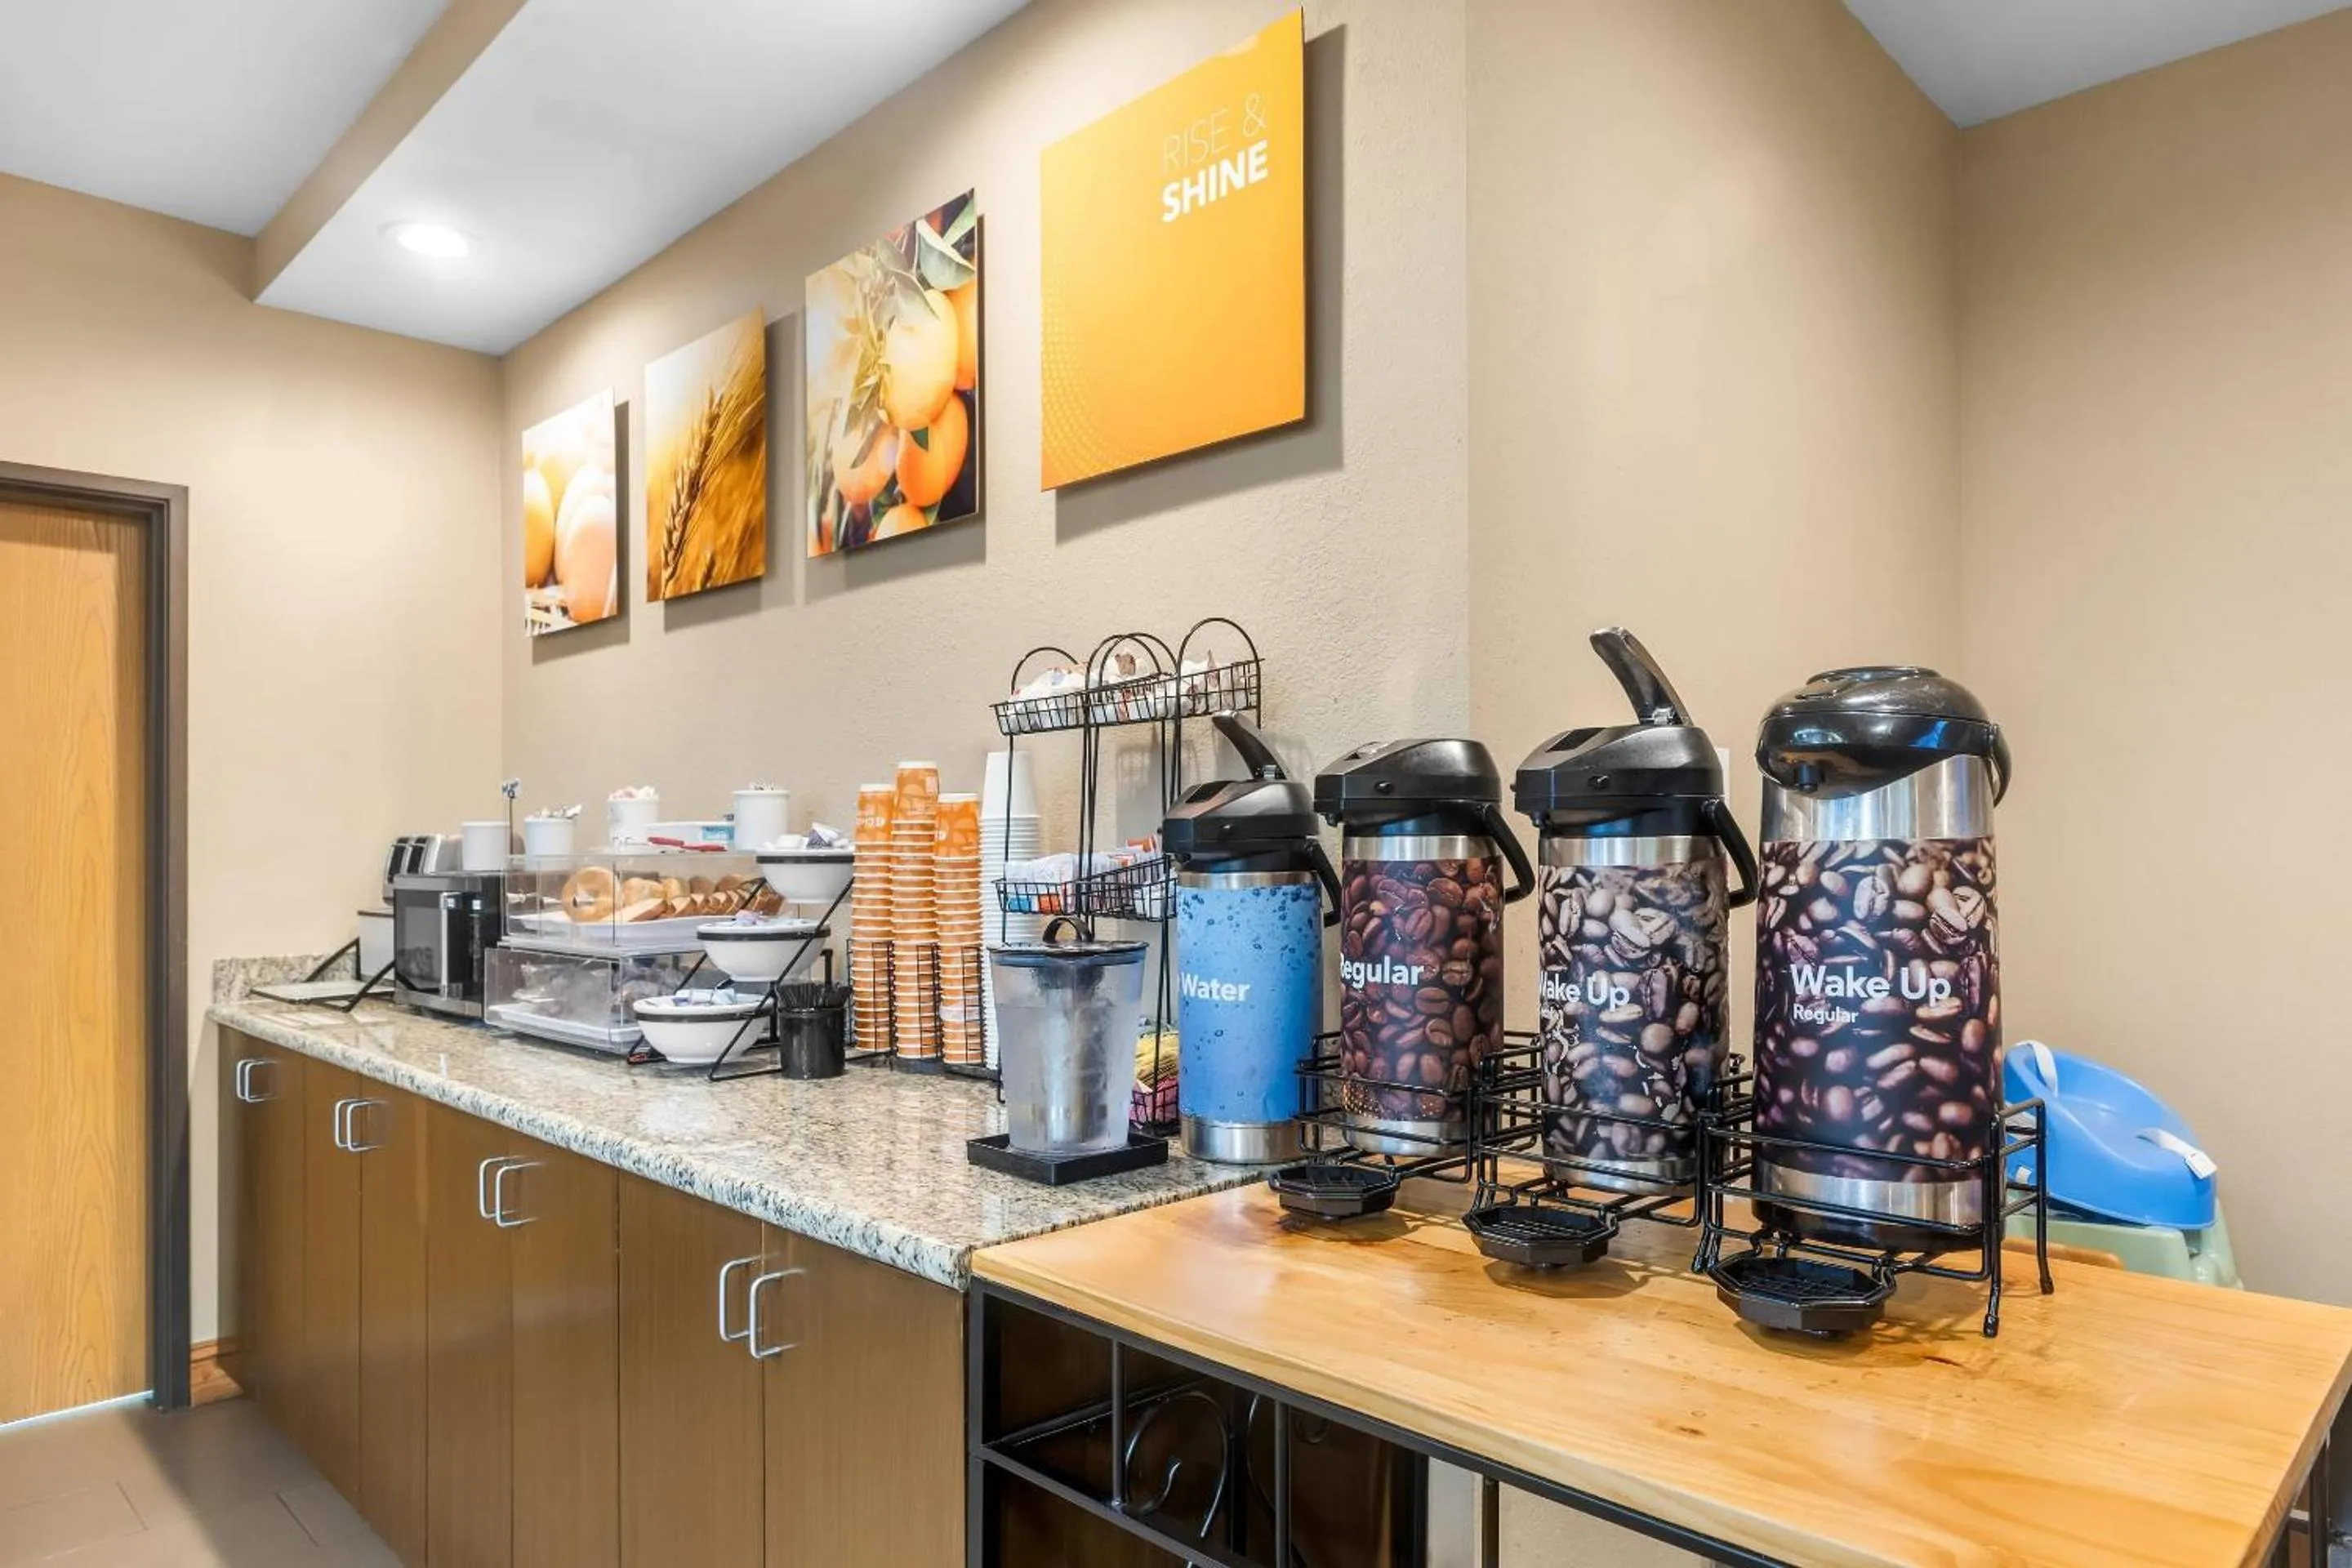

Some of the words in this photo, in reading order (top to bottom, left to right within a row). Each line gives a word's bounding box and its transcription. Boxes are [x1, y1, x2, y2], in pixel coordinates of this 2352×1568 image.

[1161, 105, 1228, 174] RISE
[1242, 92, 1268, 137] &
[1161, 140, 1269, 223] SHINE
[1181, 971, 1251, 1002] Water
[1587, 974, 1631, 1013] Up
[1790, 964, 1890, 998] Wake
[1900, 967, 1952, 1007] Up
[1793, 1003, 1860, 1025] Regular
